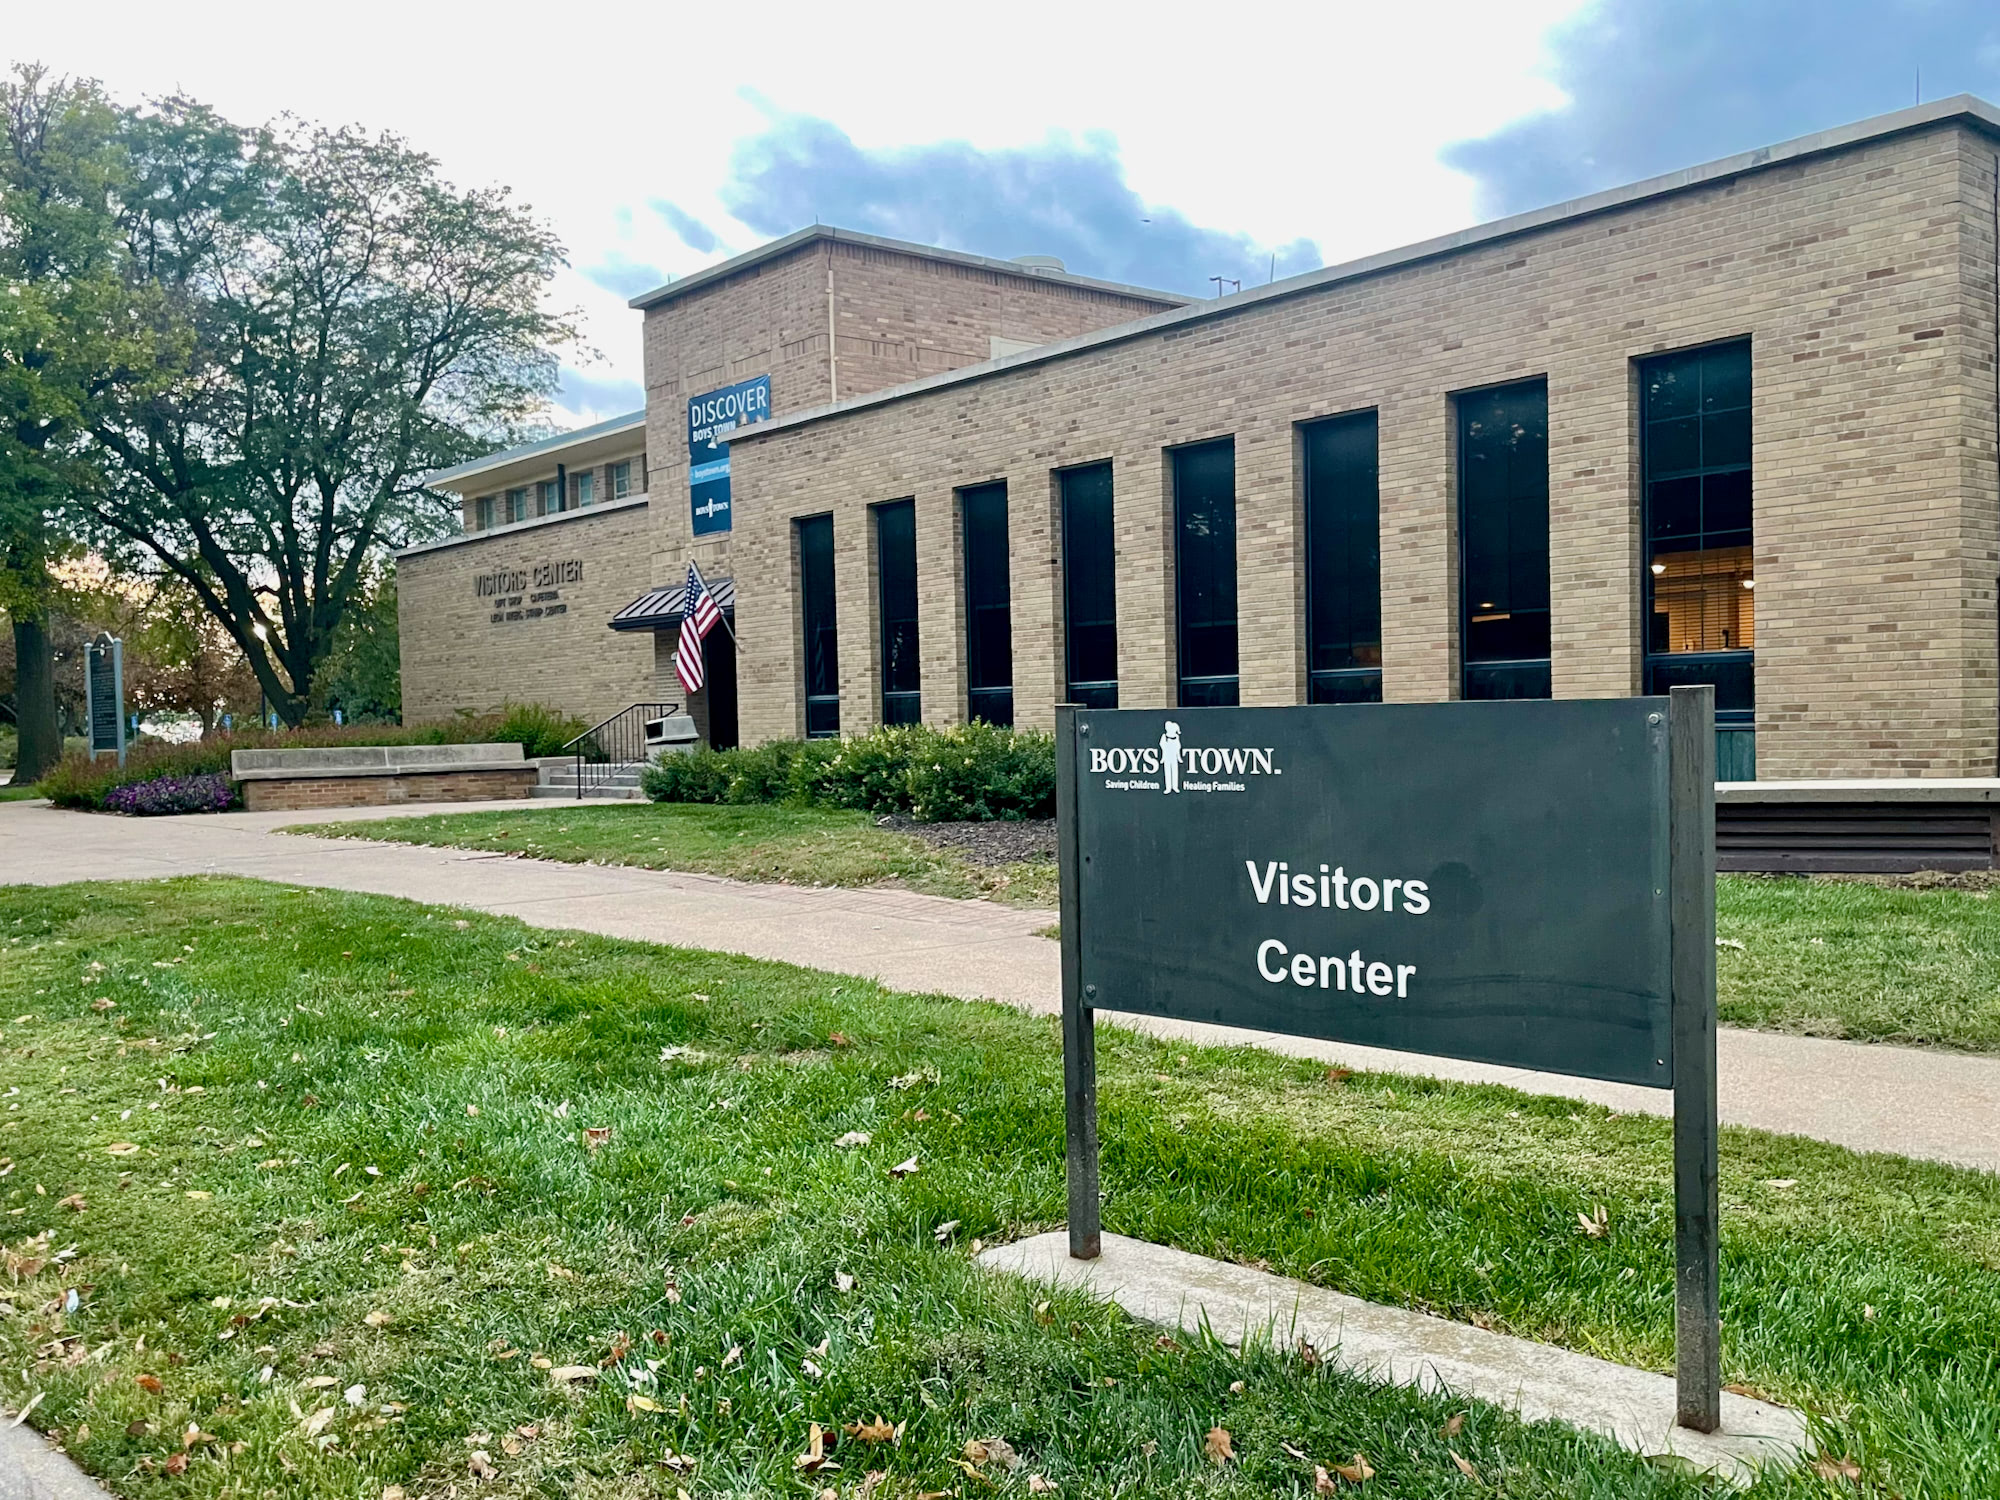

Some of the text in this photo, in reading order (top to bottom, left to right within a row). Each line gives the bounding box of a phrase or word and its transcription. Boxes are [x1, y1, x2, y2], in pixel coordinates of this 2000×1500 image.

[691, 385, 767, 428] DISCOVER
[692, 420, 736, 442] BOYS TOWN
[474, 559, 584, 597] VISITORS CENTER
[1089, 747, 1160, 774] BOYS
[1105, 779, 1246, 793] Saving Children Healing Families
[1245, 860, 1431, 915] Visitors
[1256, 938, 1417, 998] Center
